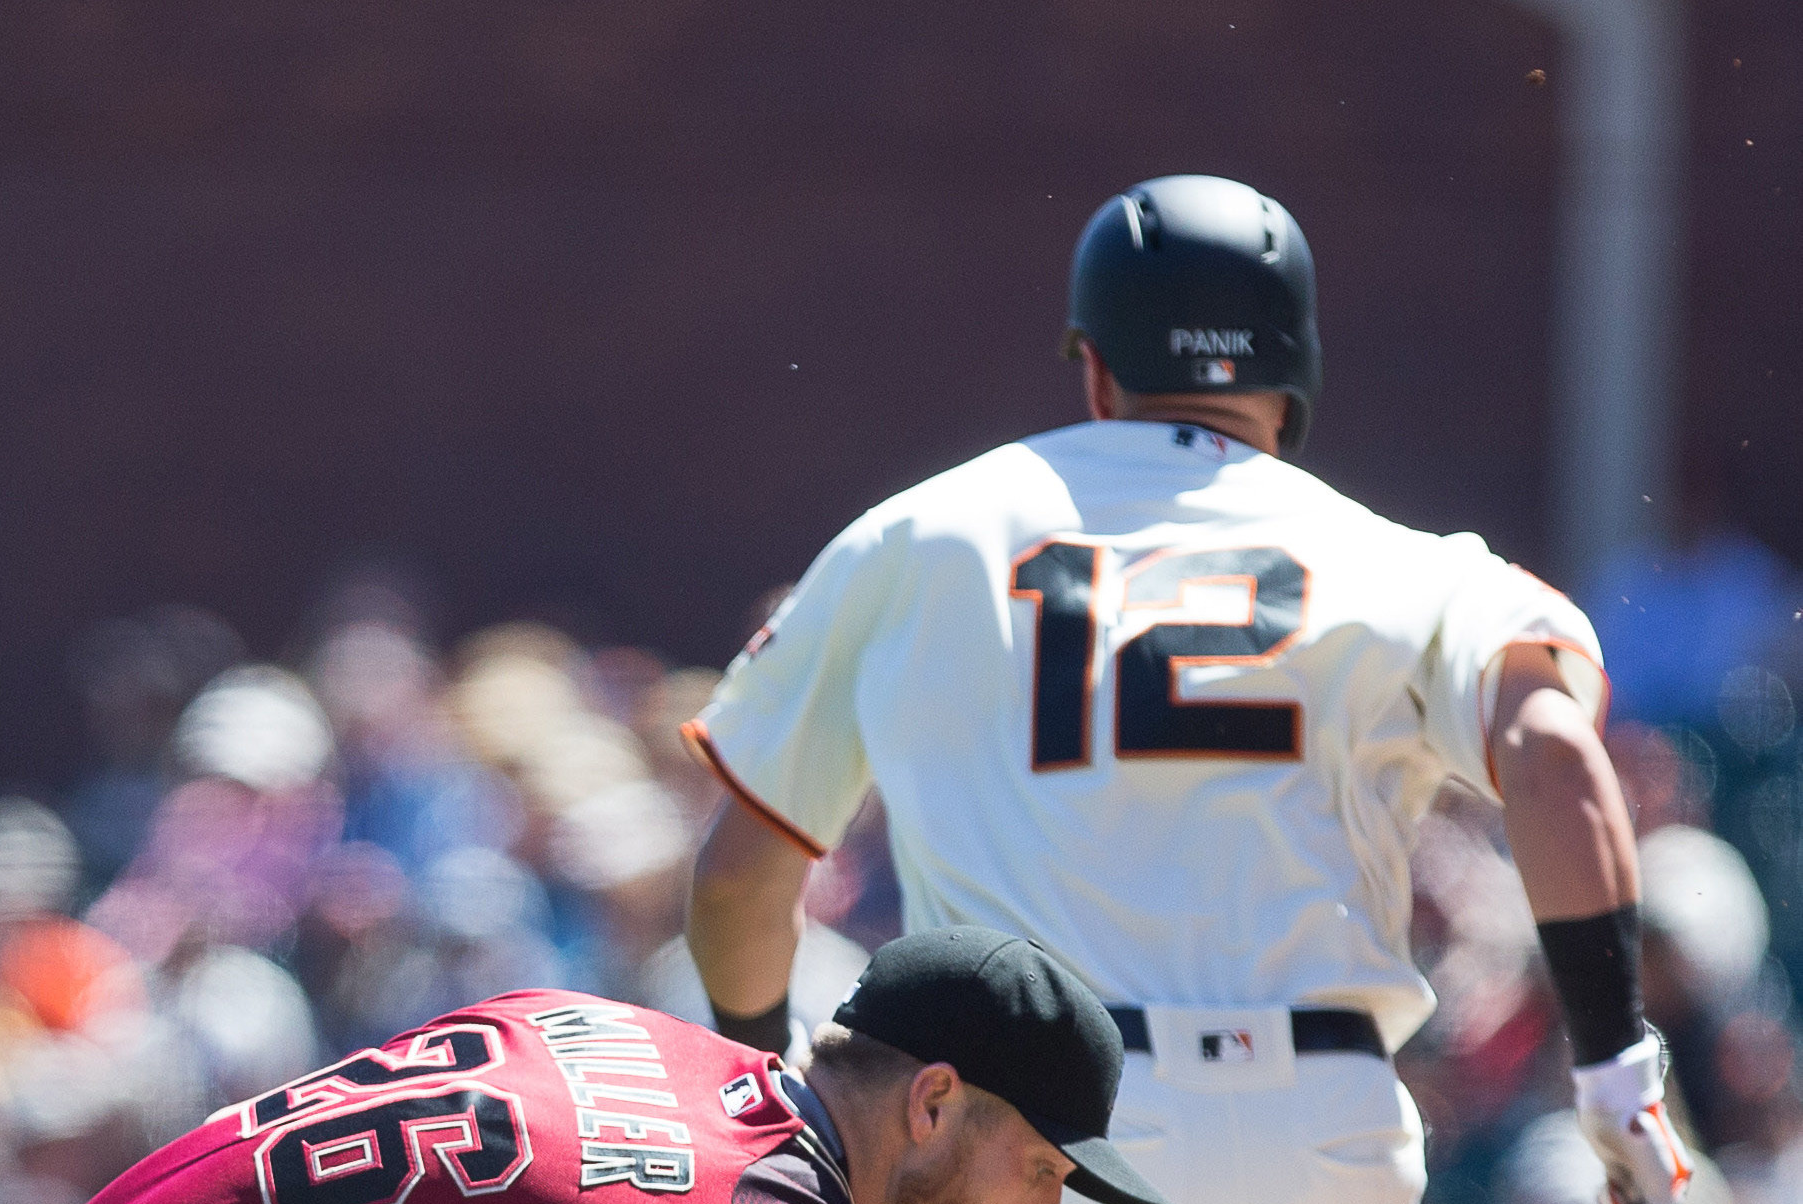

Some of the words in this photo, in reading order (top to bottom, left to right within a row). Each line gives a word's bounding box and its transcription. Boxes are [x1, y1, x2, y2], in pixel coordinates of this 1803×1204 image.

[1171, 328, 1254, 355] PANIK
[1008, 537, 1312, 773] 12
[526, 1004, 696, 1192] MILLER
